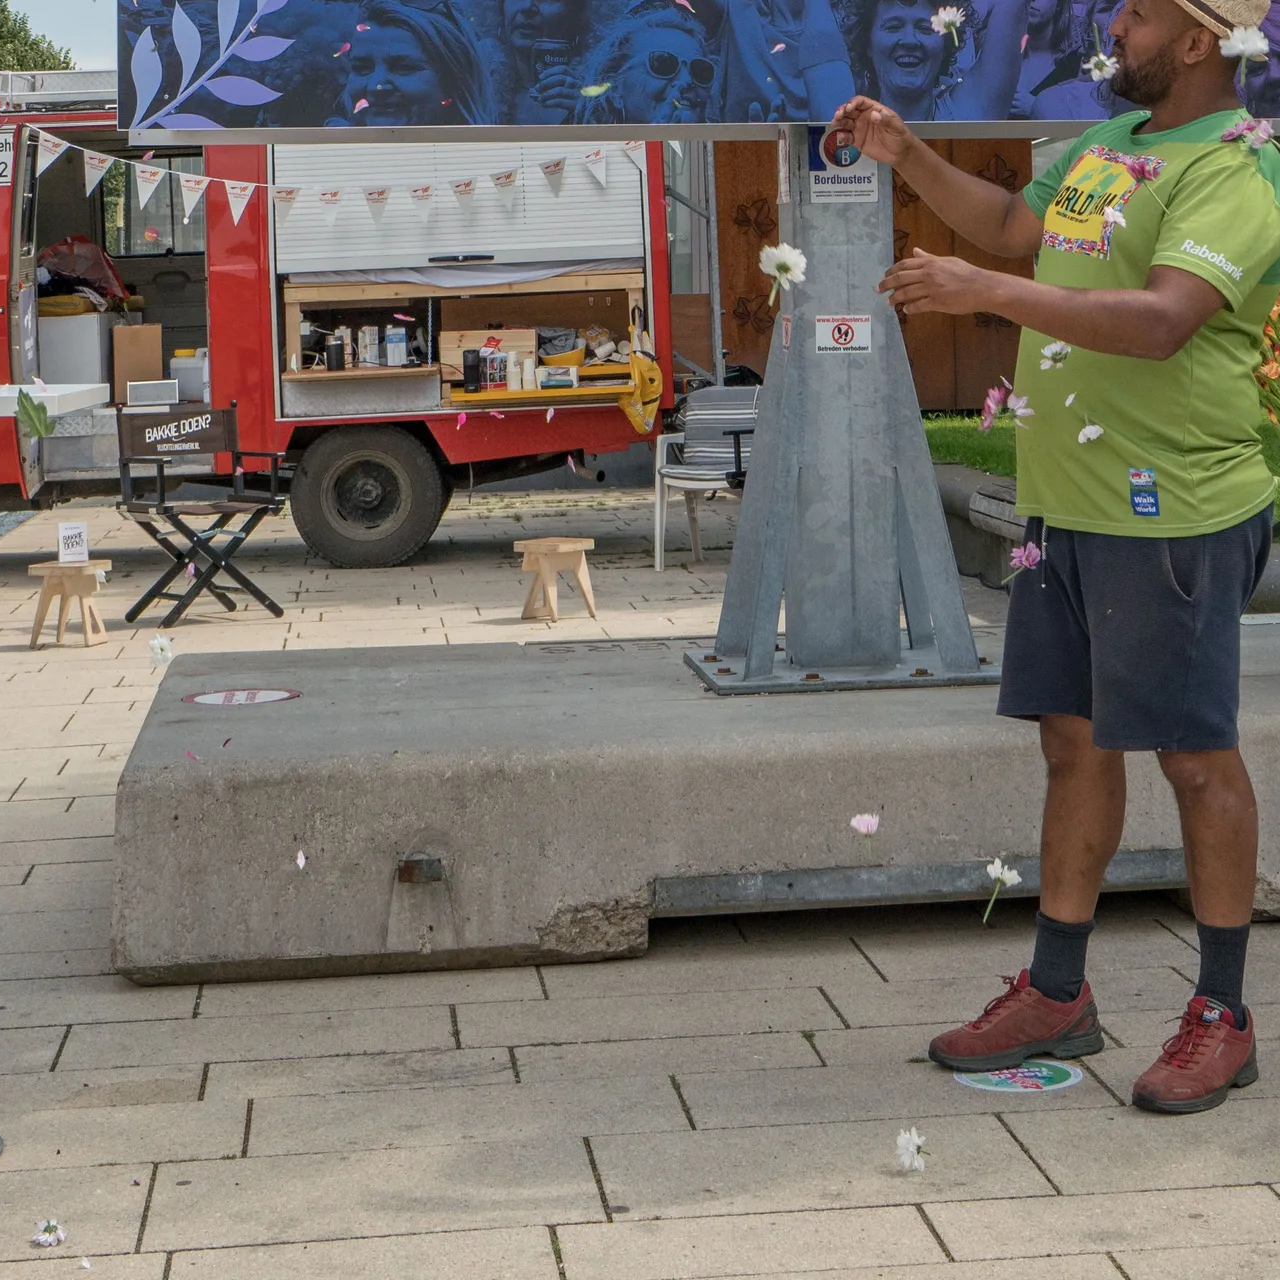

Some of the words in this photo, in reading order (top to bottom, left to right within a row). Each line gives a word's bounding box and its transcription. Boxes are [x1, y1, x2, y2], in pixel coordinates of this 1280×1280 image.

[1181, 238, 1244, 282] Rabobank
[145, 422, 179, 443] BAKKIE
[180, 414, 211, 435] DOEN?
[1134, 496, 1155, 504] Walk
